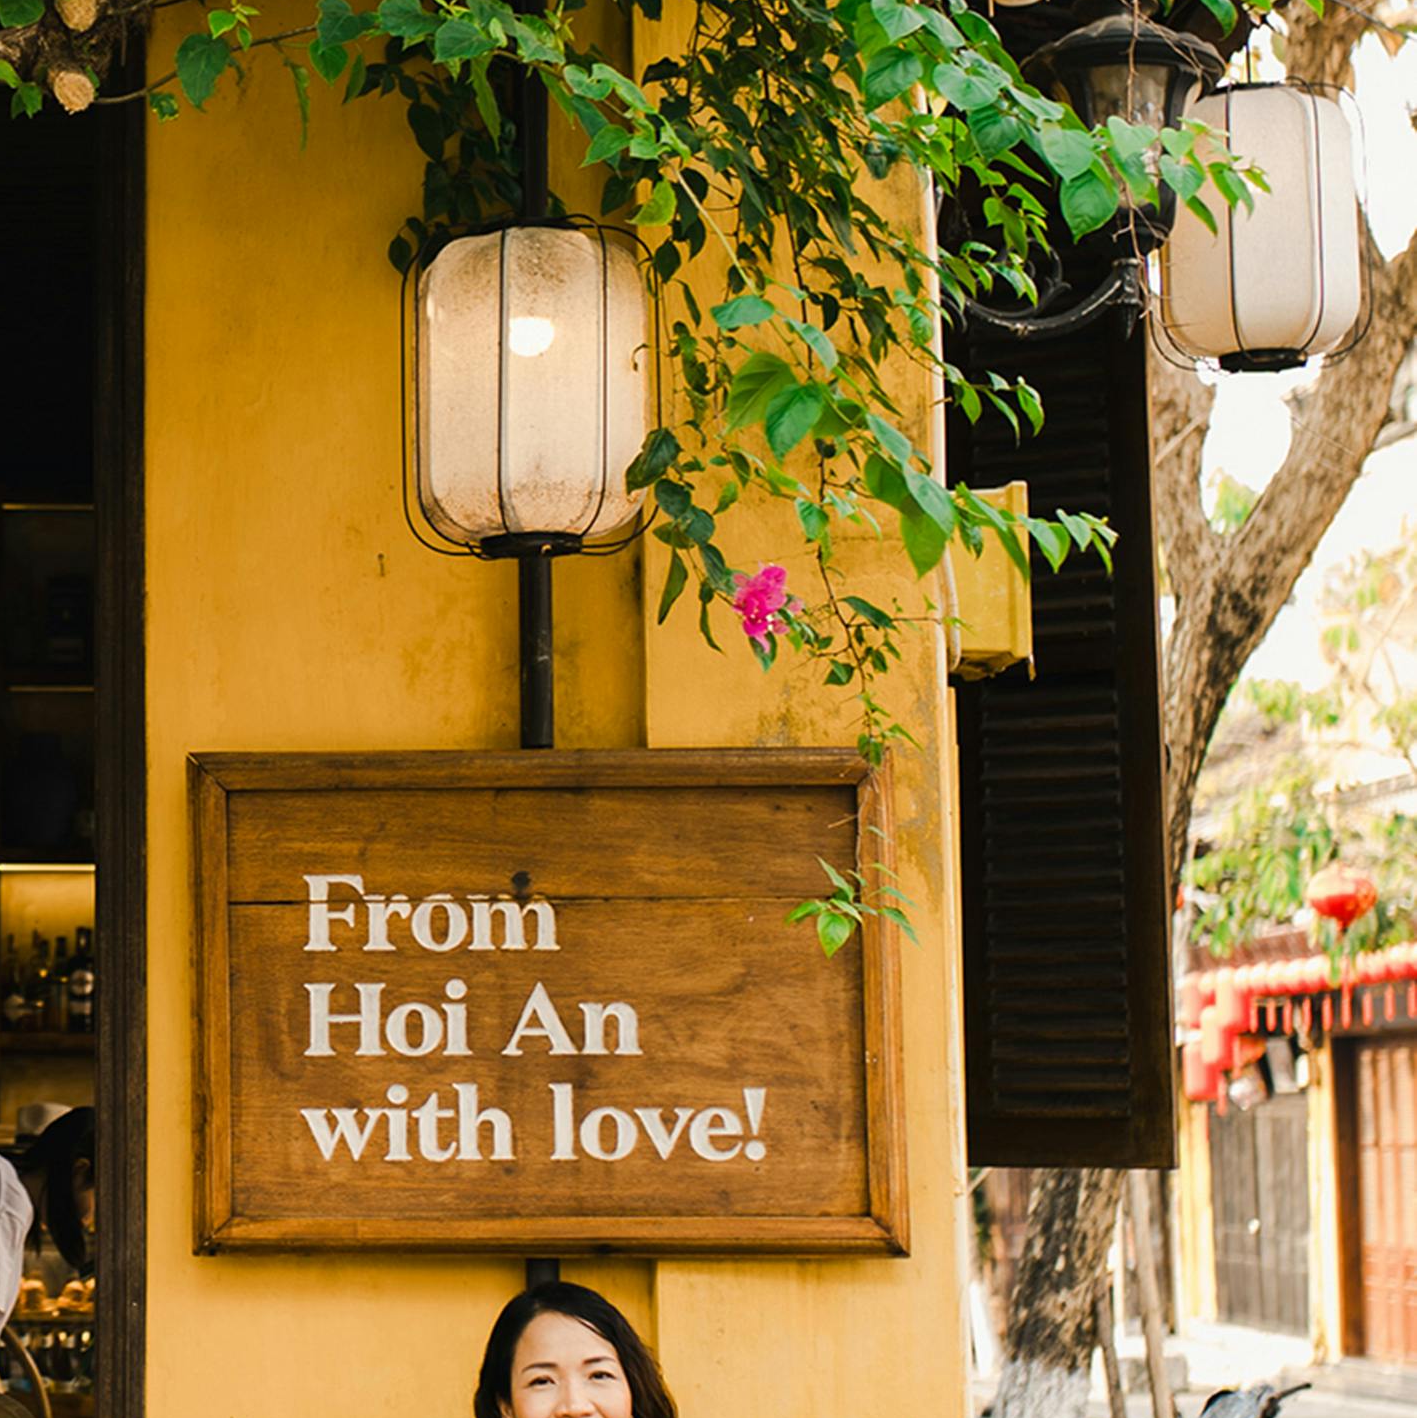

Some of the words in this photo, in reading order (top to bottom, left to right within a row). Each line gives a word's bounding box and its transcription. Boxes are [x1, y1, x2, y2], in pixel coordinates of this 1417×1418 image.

[303, 874, 561, 952] From
[303, 979, 473, 1057] Hoi
[502, 981, 643, 1056] An
[299, 1082, 515, 1162] with
[548, 1083, 767, 1162] love!
